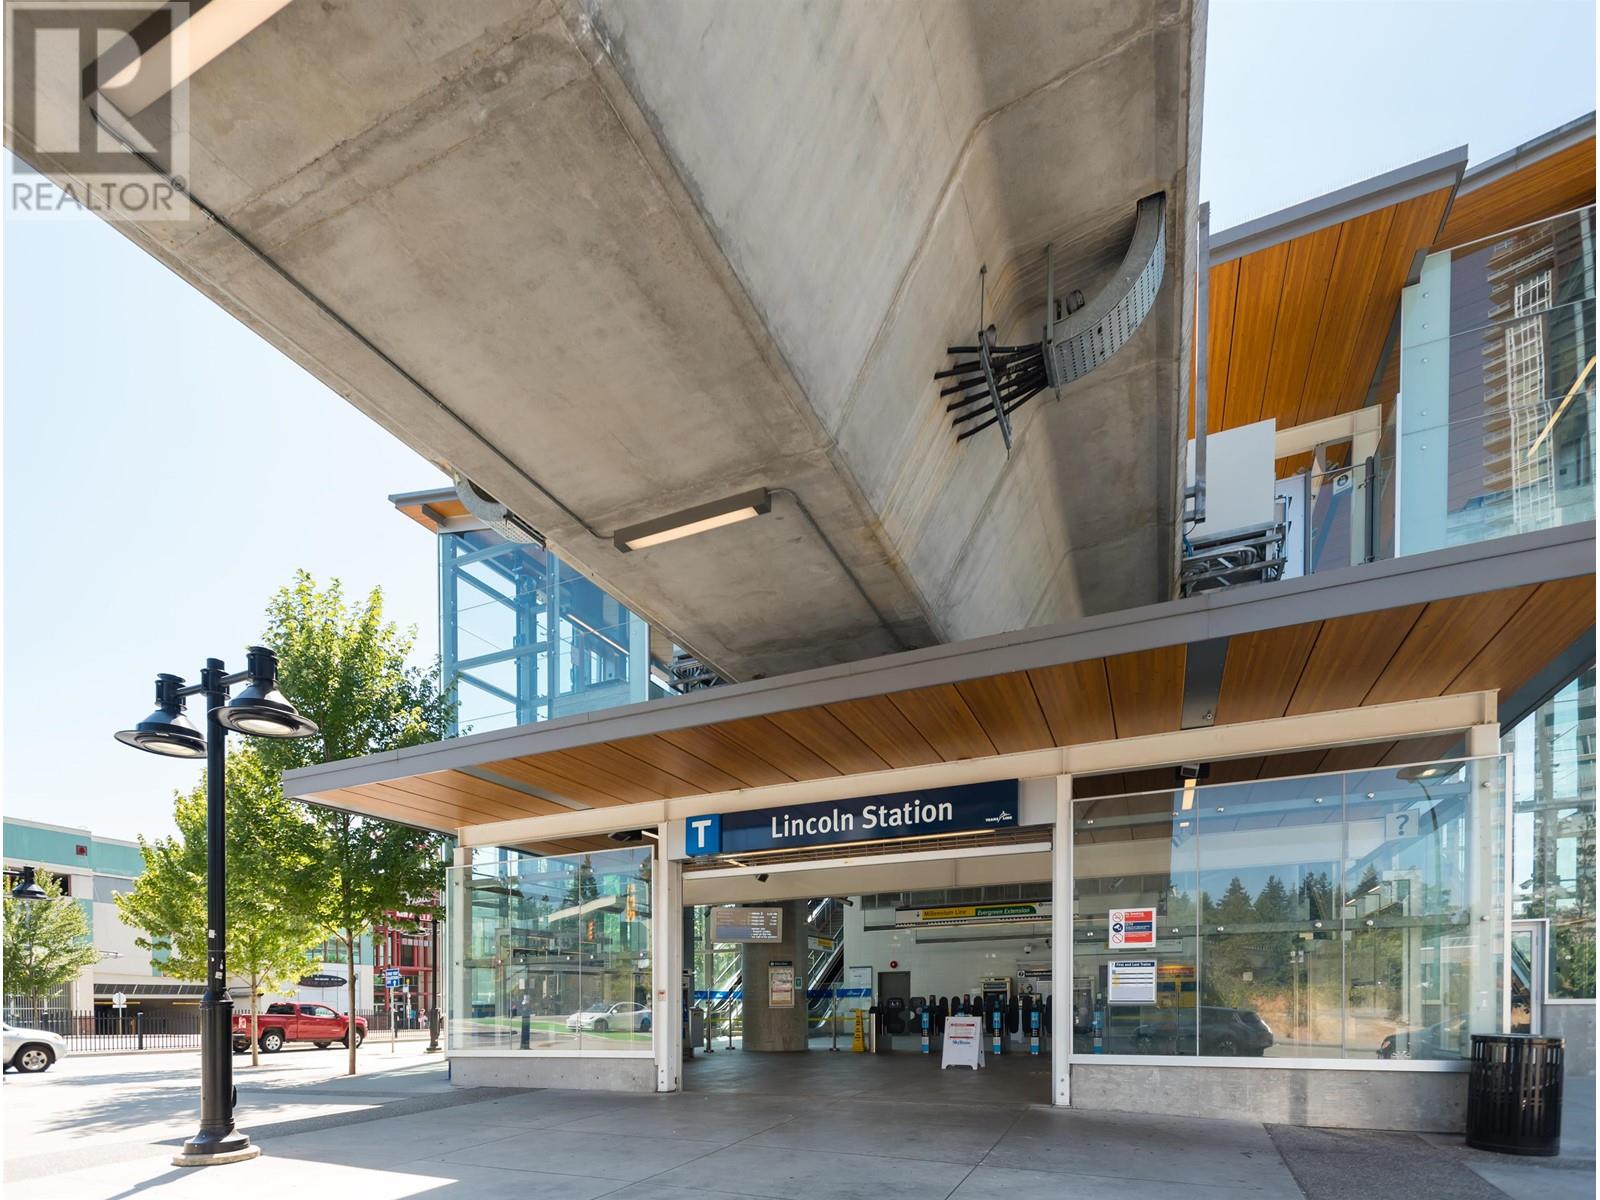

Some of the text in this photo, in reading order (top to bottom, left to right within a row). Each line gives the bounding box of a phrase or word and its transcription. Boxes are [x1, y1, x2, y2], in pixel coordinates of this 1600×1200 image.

[691, 819, 712, 848] T
[771, 799, 953, 839] Lincoln Station
[977, 907, 1030, 917] Evergreen Extension
